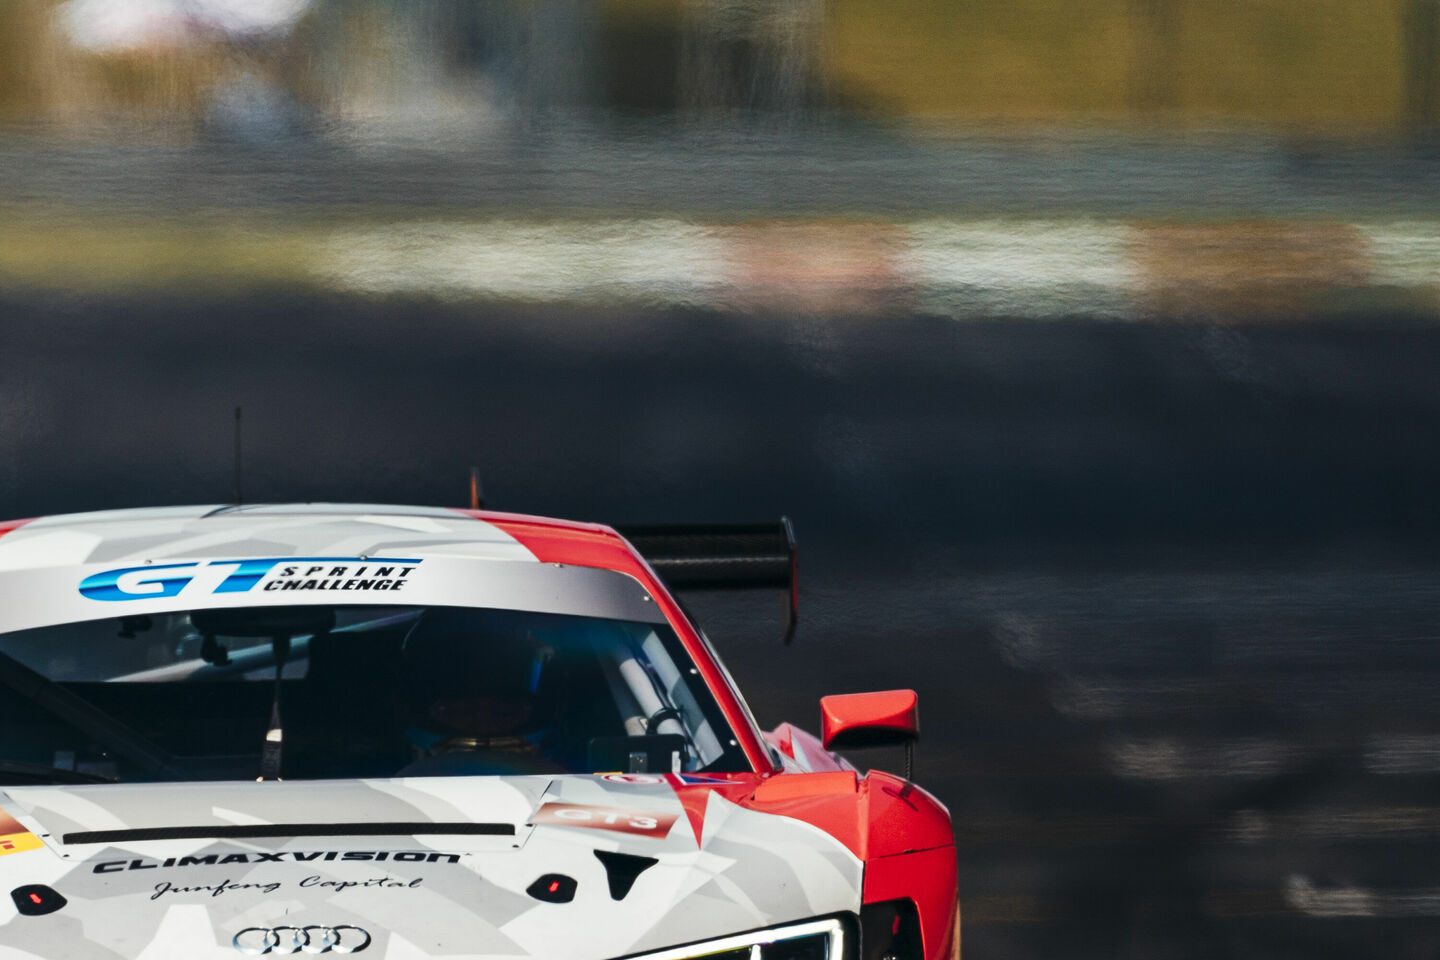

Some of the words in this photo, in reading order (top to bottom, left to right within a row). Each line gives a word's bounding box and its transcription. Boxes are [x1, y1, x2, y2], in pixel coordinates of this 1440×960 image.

[78, 558, 282, 601] GT
[282, 566, 417, 578] SPRINT
[263, 579, 409, 592] CHALLENGE
[554, 808, 658, 830] GT3
[92, 851, 462, 874] CLIMAXVISION
[150, 880, 281, 900] Junfeng
[298, 875, 425, 891] Capital
